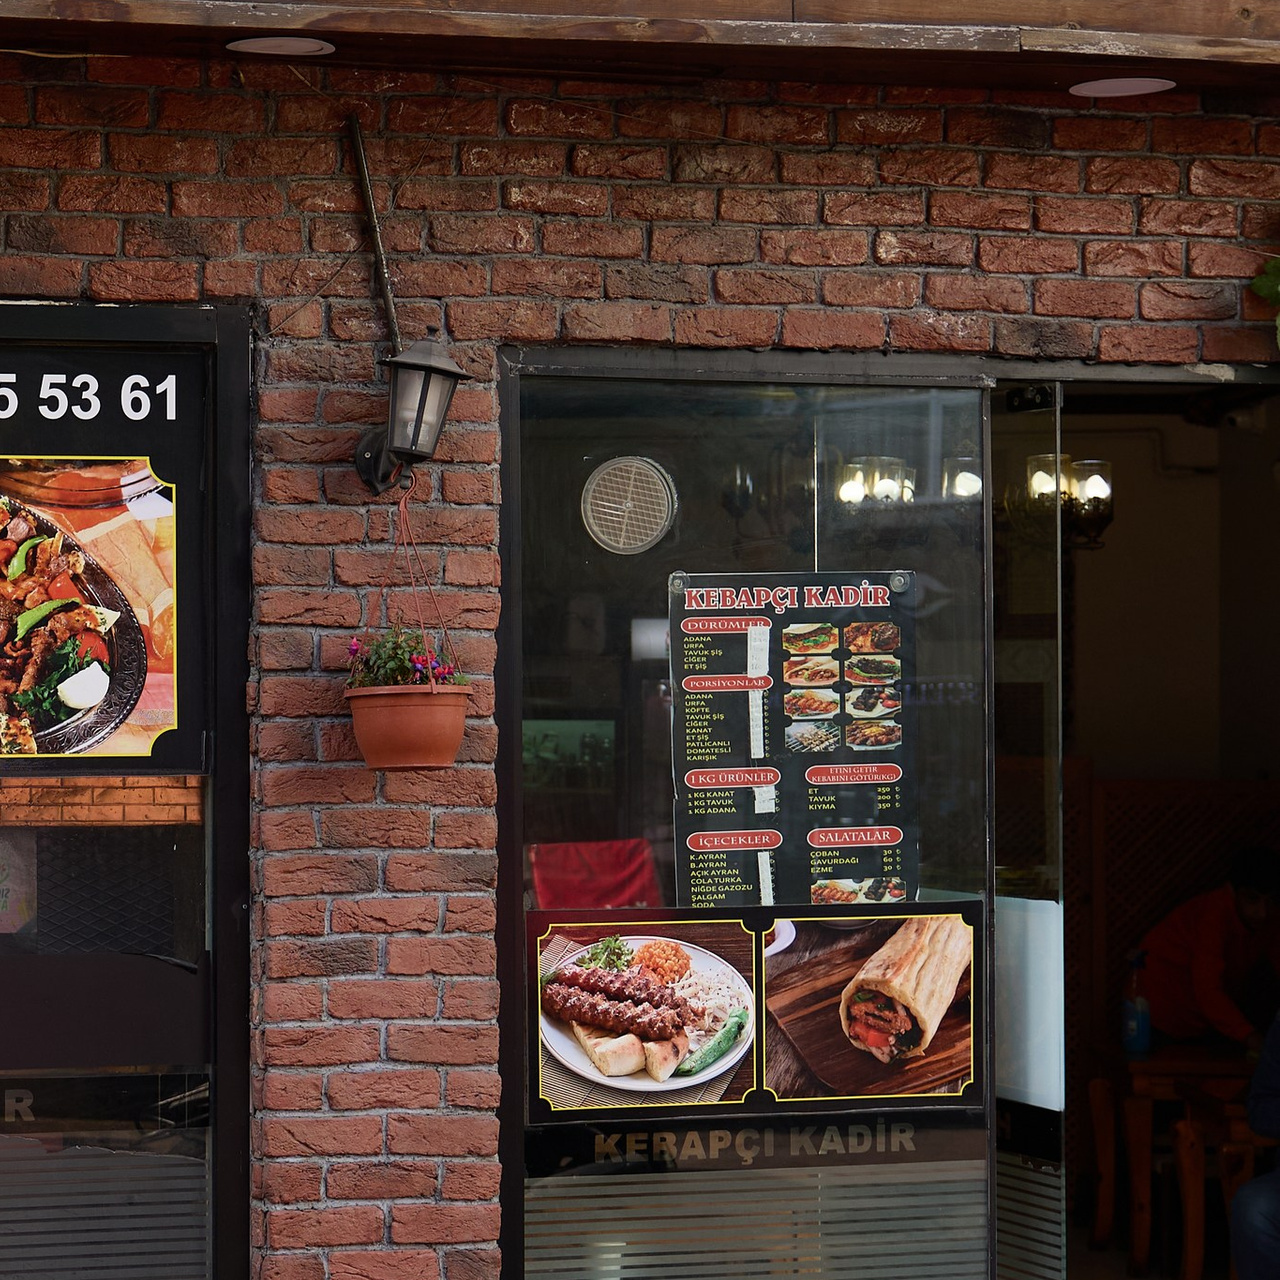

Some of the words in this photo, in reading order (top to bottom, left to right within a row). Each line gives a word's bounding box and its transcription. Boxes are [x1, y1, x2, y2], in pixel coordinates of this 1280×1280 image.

[39, 373, 101, 421] 53
[120, 373, 177, 421] 61
[684, 586, 798, 614] KEBAPÇI
[804, 580, 890, 607] KADİR
[688, 620, 765, 630] DÜRÜMLER
[690, 678, 765, 688] PORSİYONLAR
[698, 775, 716, 783] KG
[719, 771, 775, 783] ÜRÜNLER
[699, 834, 770, 848] İÇECEKLER
[819, 830, 891, 843] SALATALAR
[810, 850, 840, 858] ÇOBAN
[810, 857, 859, 866] GAVURDAĞI
[690, 870, 709, 878] AÇIK
[691, 877, 713, 885] COLA
[691, 885, 717, 893] NİĞDE
[691, 893, 726, 902] ŞALGAM
[593, 1128, 775, 1166] KEBAPÇI
[789, 1117, 917, 1156] KADİR
